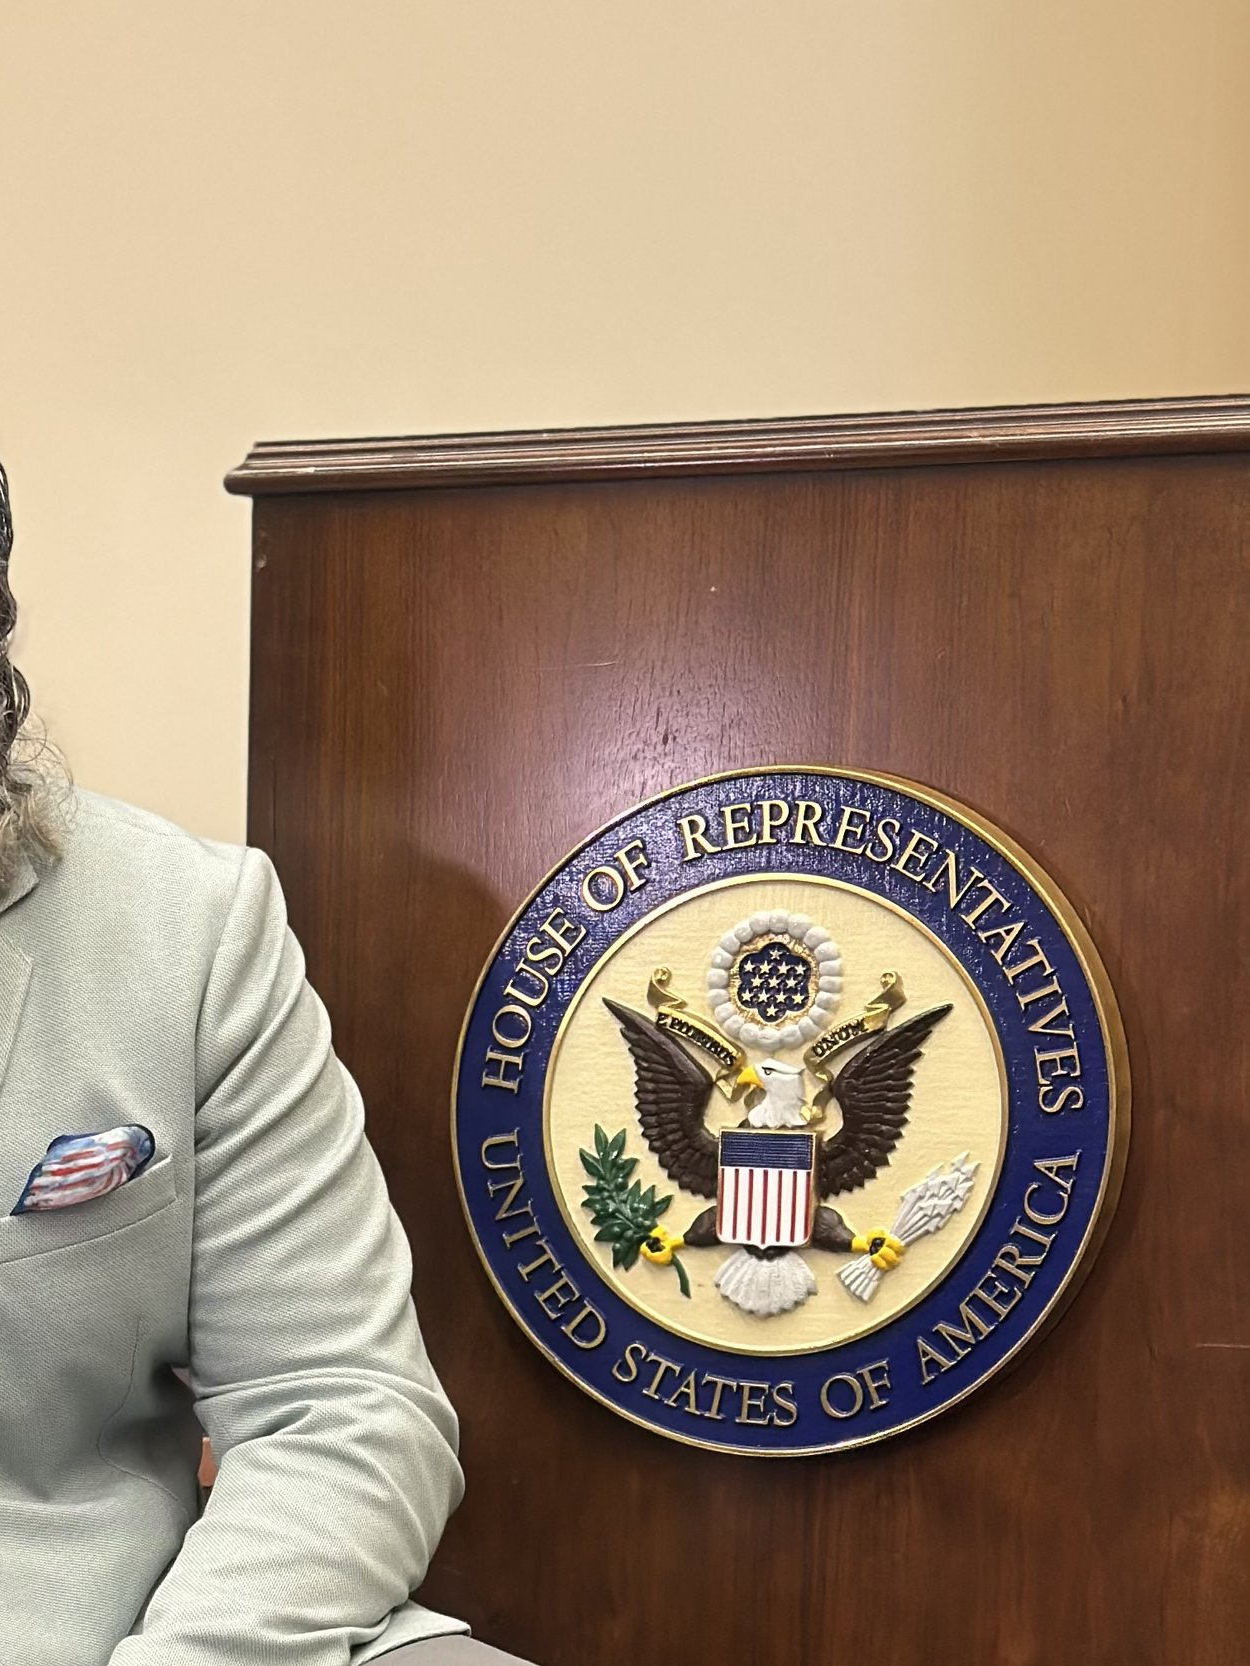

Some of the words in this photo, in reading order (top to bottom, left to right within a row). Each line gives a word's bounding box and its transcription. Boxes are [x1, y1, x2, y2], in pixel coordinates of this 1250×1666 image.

[483, 909, 586, 1092] HOUSE
[582, 840, 650, 912] OF
[677, 799, 1083, 1114] REPRESENTATIVES
[481, 1128, 607, 1349] UNITED
[613, 1342, 798, 1427] STATES
[820, 1359, 893, 1420] OF
[914, 1150, 1081, 1385] AMERICA
